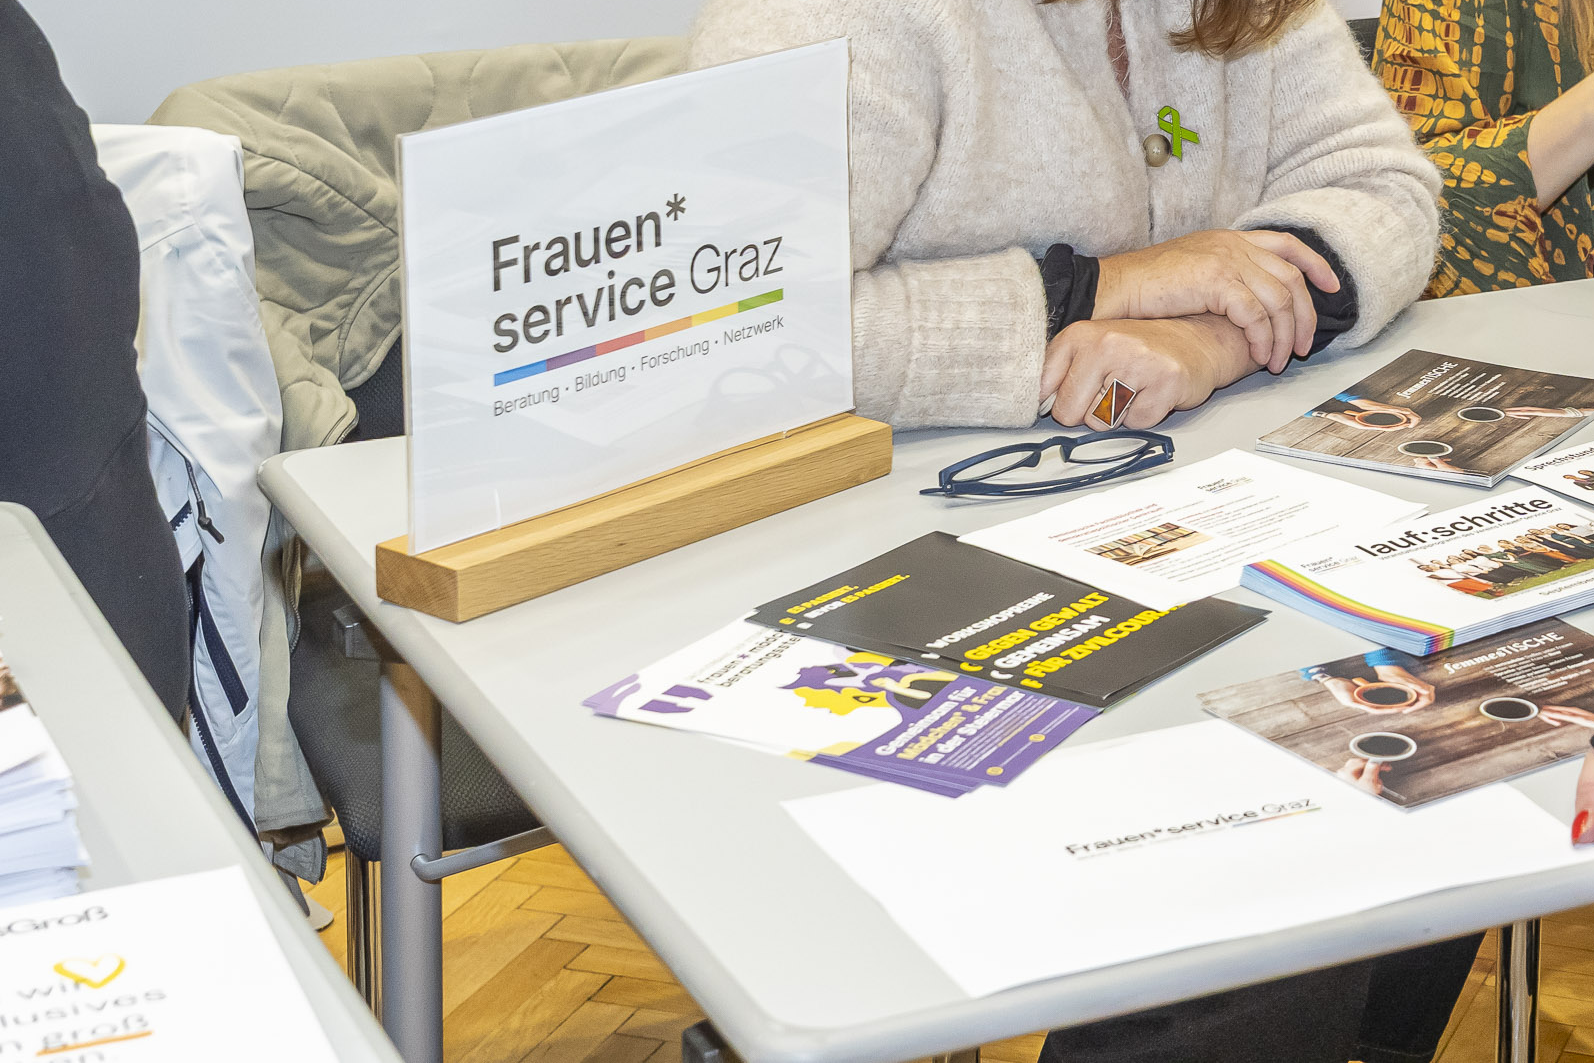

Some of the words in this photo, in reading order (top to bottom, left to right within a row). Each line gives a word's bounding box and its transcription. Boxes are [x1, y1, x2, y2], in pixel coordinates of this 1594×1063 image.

[492, 269, 676, 353] service
[690, 236, 784, 294] Graz
[493, 386, 561, 417] Beratung
[574, 365, 627, 393] Bildung
[640, 340, 711, 371] Forschung
[722, 315, 785, 346] Netzwerk
[1354, 496, 1554, 558] lauf:schritte
[964, 628, 1038, 660] GEGEN
[1029, 592, 1109, 631] GEWALT
[994, 614, 1110, 669] GEMEINSAM
[1443, 631, 1565, 674] femmesTISCHE
[1024, 655, 1072, 678] FÜR
[875, 700, 960, 756] Gemeinsam
[947, 686, 978, 702] für
[918, 752, 946, 764] in
[936, 735, 967, 754] der
[1261, 798, 1315, 815] Graz
